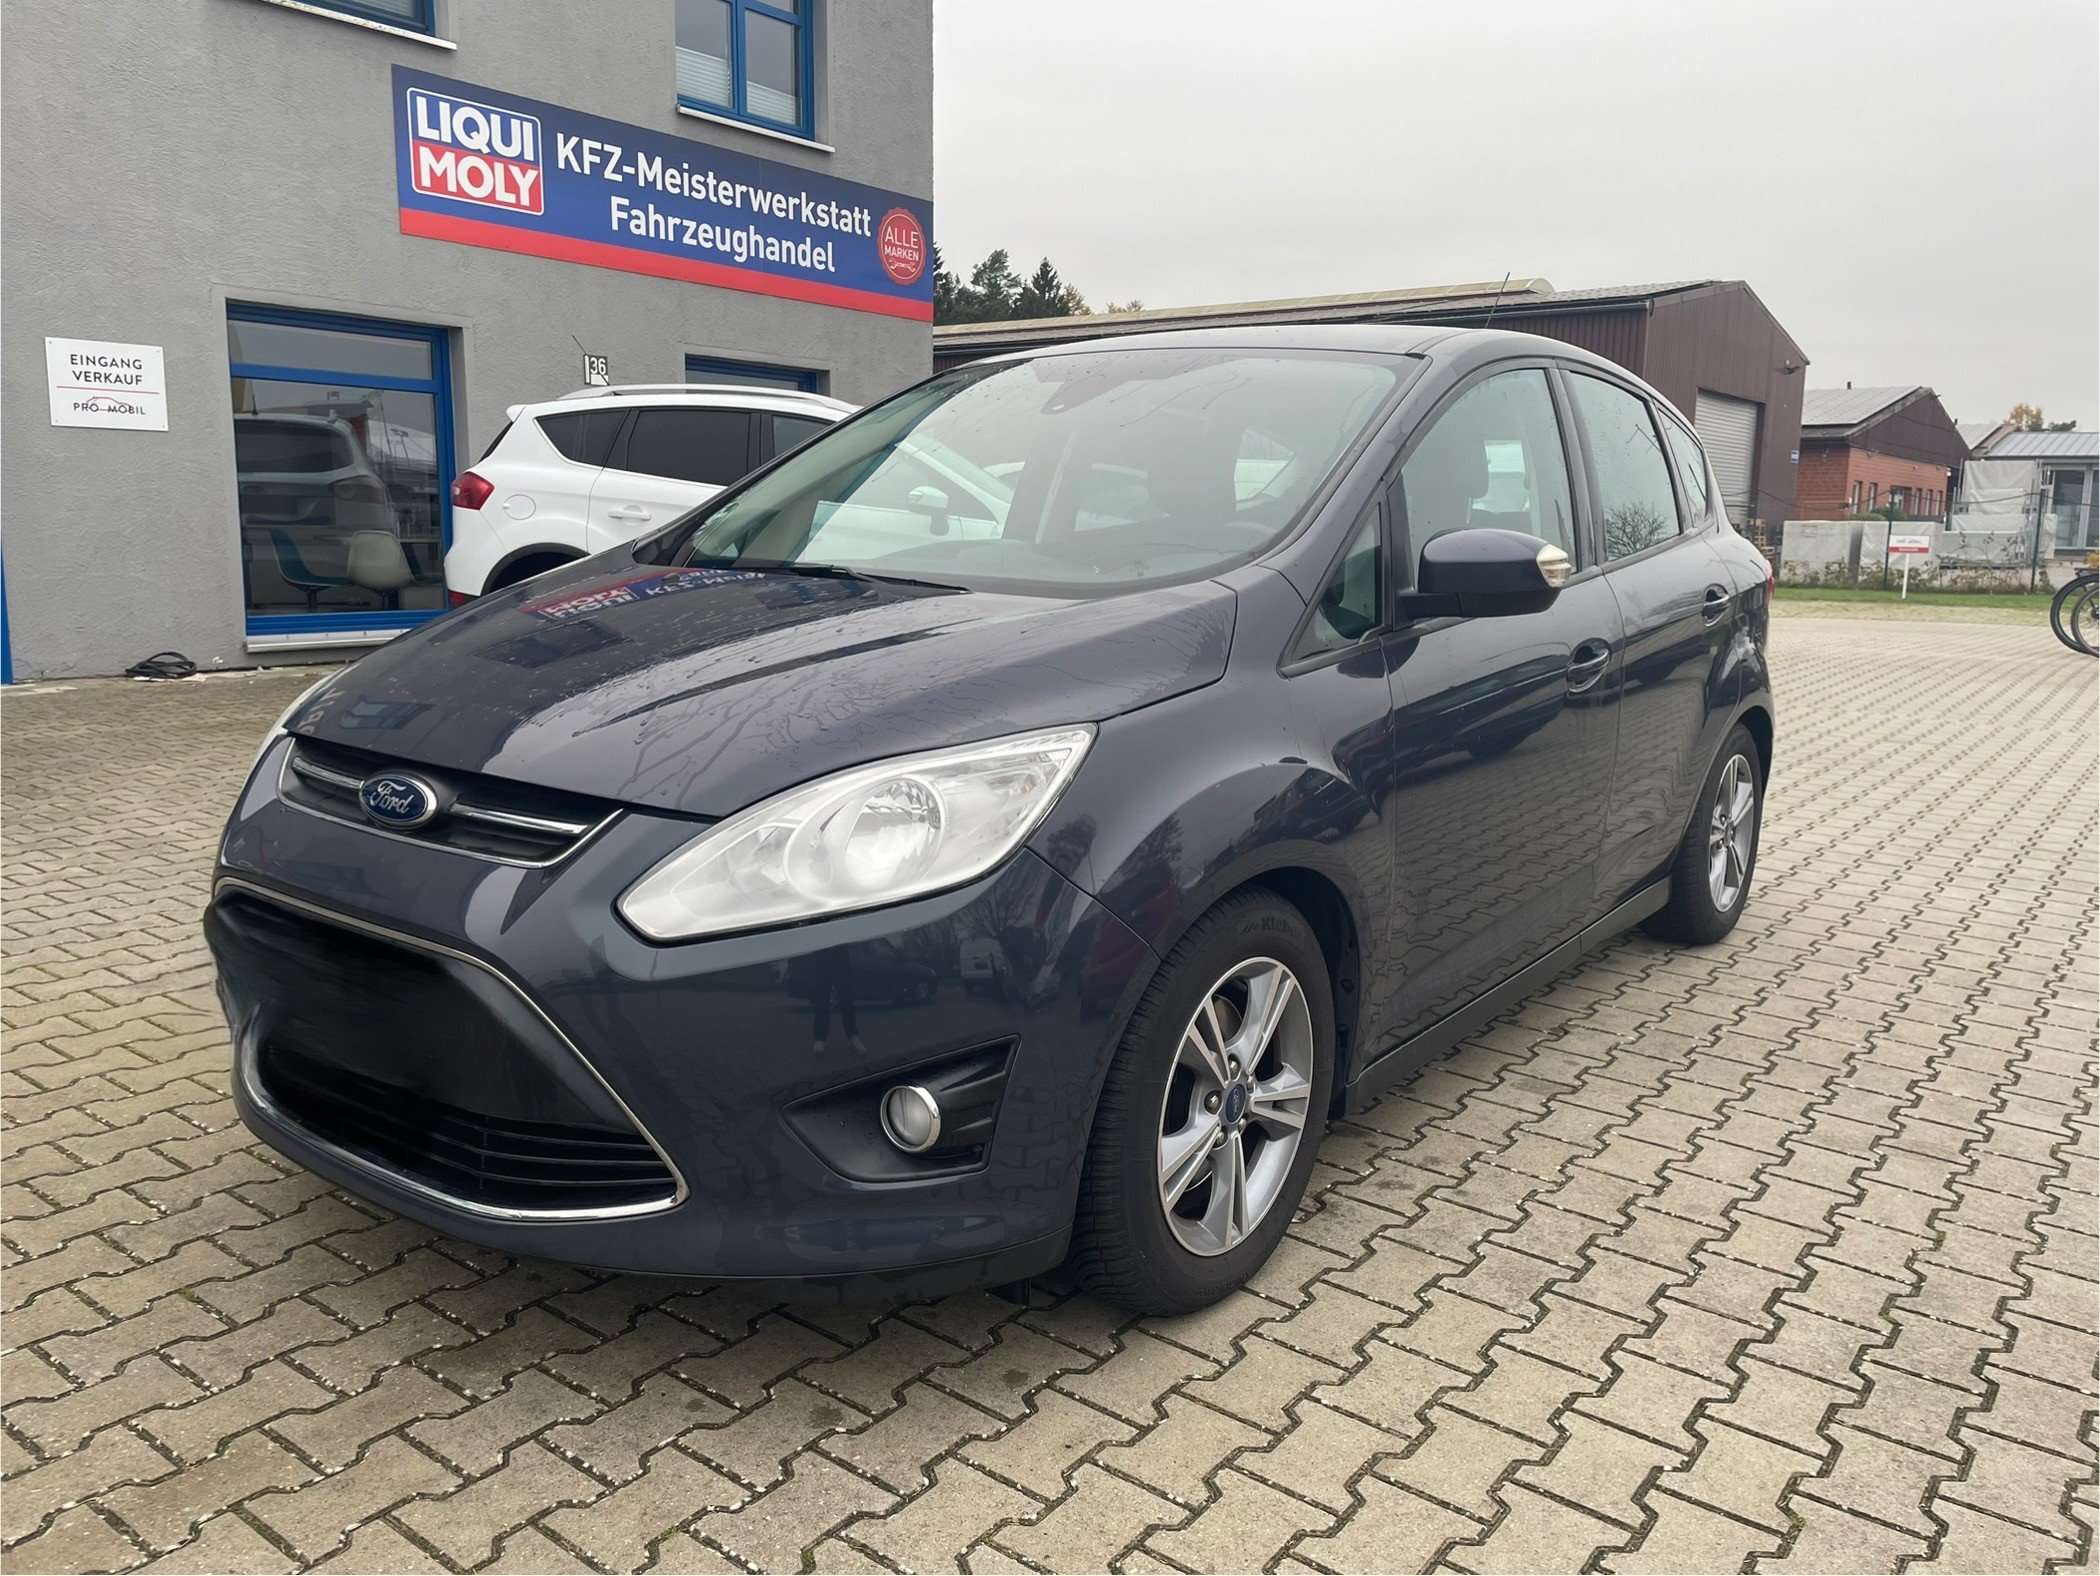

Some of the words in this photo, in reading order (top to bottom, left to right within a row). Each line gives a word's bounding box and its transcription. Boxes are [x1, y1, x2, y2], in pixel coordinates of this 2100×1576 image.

[416, 95, 535, 161] LIQUI
[418, 145, 539, 207] MOLY
[556, 132, 872, 237] KFZ-Meisterwerkstatt
[610, 195, 836, 273] Fahrzeughandel
[884, 225, 919, 249] ALLE
[883, 243, 920, 262] MARKEN
[70, 353, 143, 370] EINGANG
[590, 356, 606, 375] 36
[72, 369, 143, 385] VERKAUF
[73, 402, 99, 413] PRO
[108, 404, 146, 416] MOBIL
[369, 780, 415, 814] Ford
